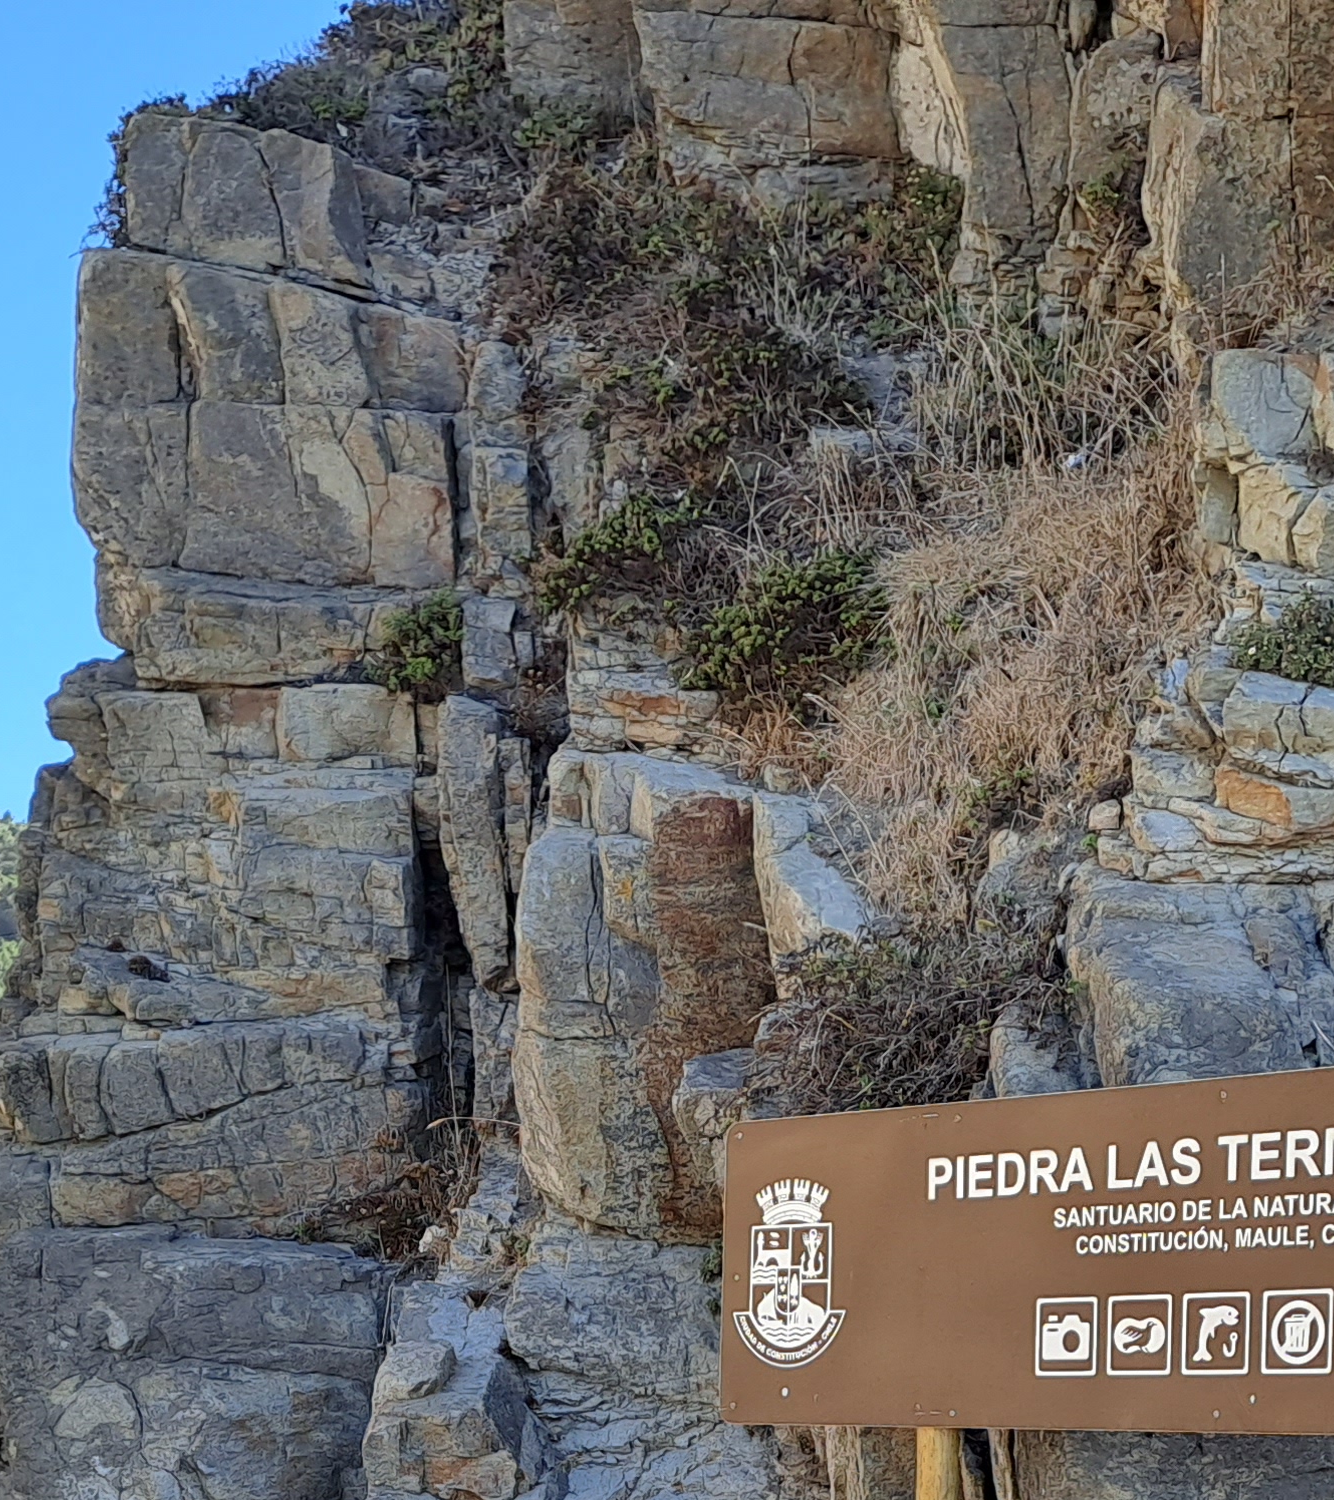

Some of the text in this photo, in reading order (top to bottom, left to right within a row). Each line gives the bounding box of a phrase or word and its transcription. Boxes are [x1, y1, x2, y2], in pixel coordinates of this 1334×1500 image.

[928, 1147, 1094, 1201] PIEDRA
[1107, 1138, 1201, 1189] LAS
[1053, 1201, 1176, 1228] SANTUARIO
[1182, 1199, 1212, 1221] DE
[1219, 1197, 1248, 1220] LA
[1075, 1225, 1229, 1255] CONSTITUCIÓN,
[1235, 1225, 1315, 1249] MAULE,
[739, 1316, 757, 1345] CIUDAD
[756, 1342, 766, 1353] DE
[766, 1341, 818, 1360] CONSTITUCIÓN
[822, 1316, 837, 1340] CHILE
